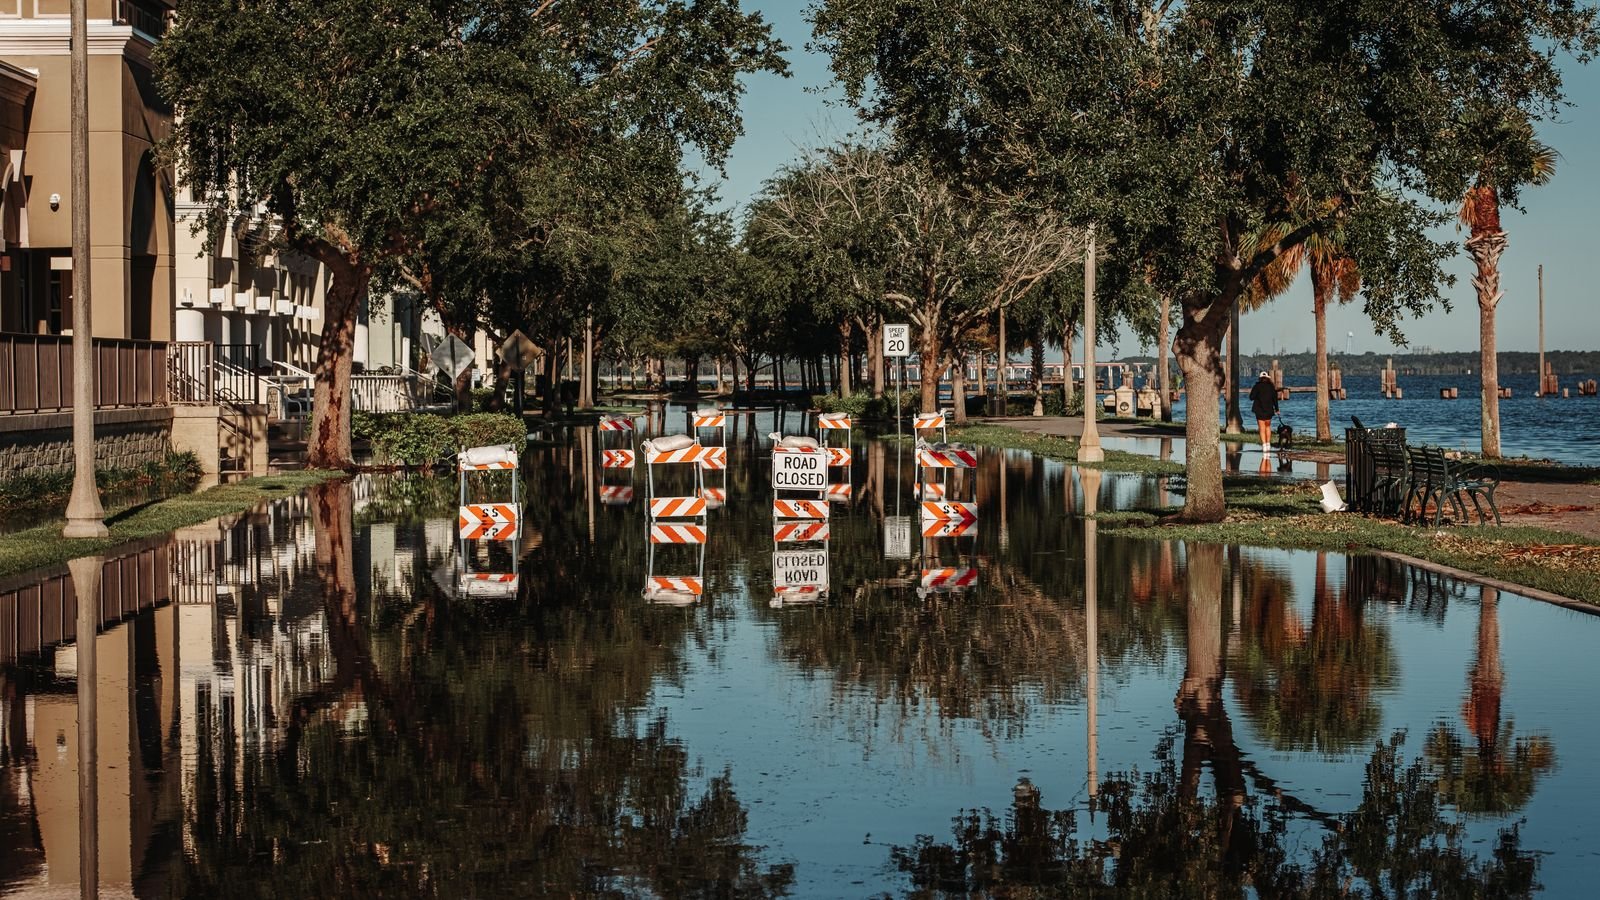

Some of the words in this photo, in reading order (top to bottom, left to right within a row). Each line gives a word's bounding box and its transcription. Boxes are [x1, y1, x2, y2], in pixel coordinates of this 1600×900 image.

[888, 340, 905, 351] 20
[784, 456, 817, 470] ROAD
[776, 472, 824, 485] CLOSED
